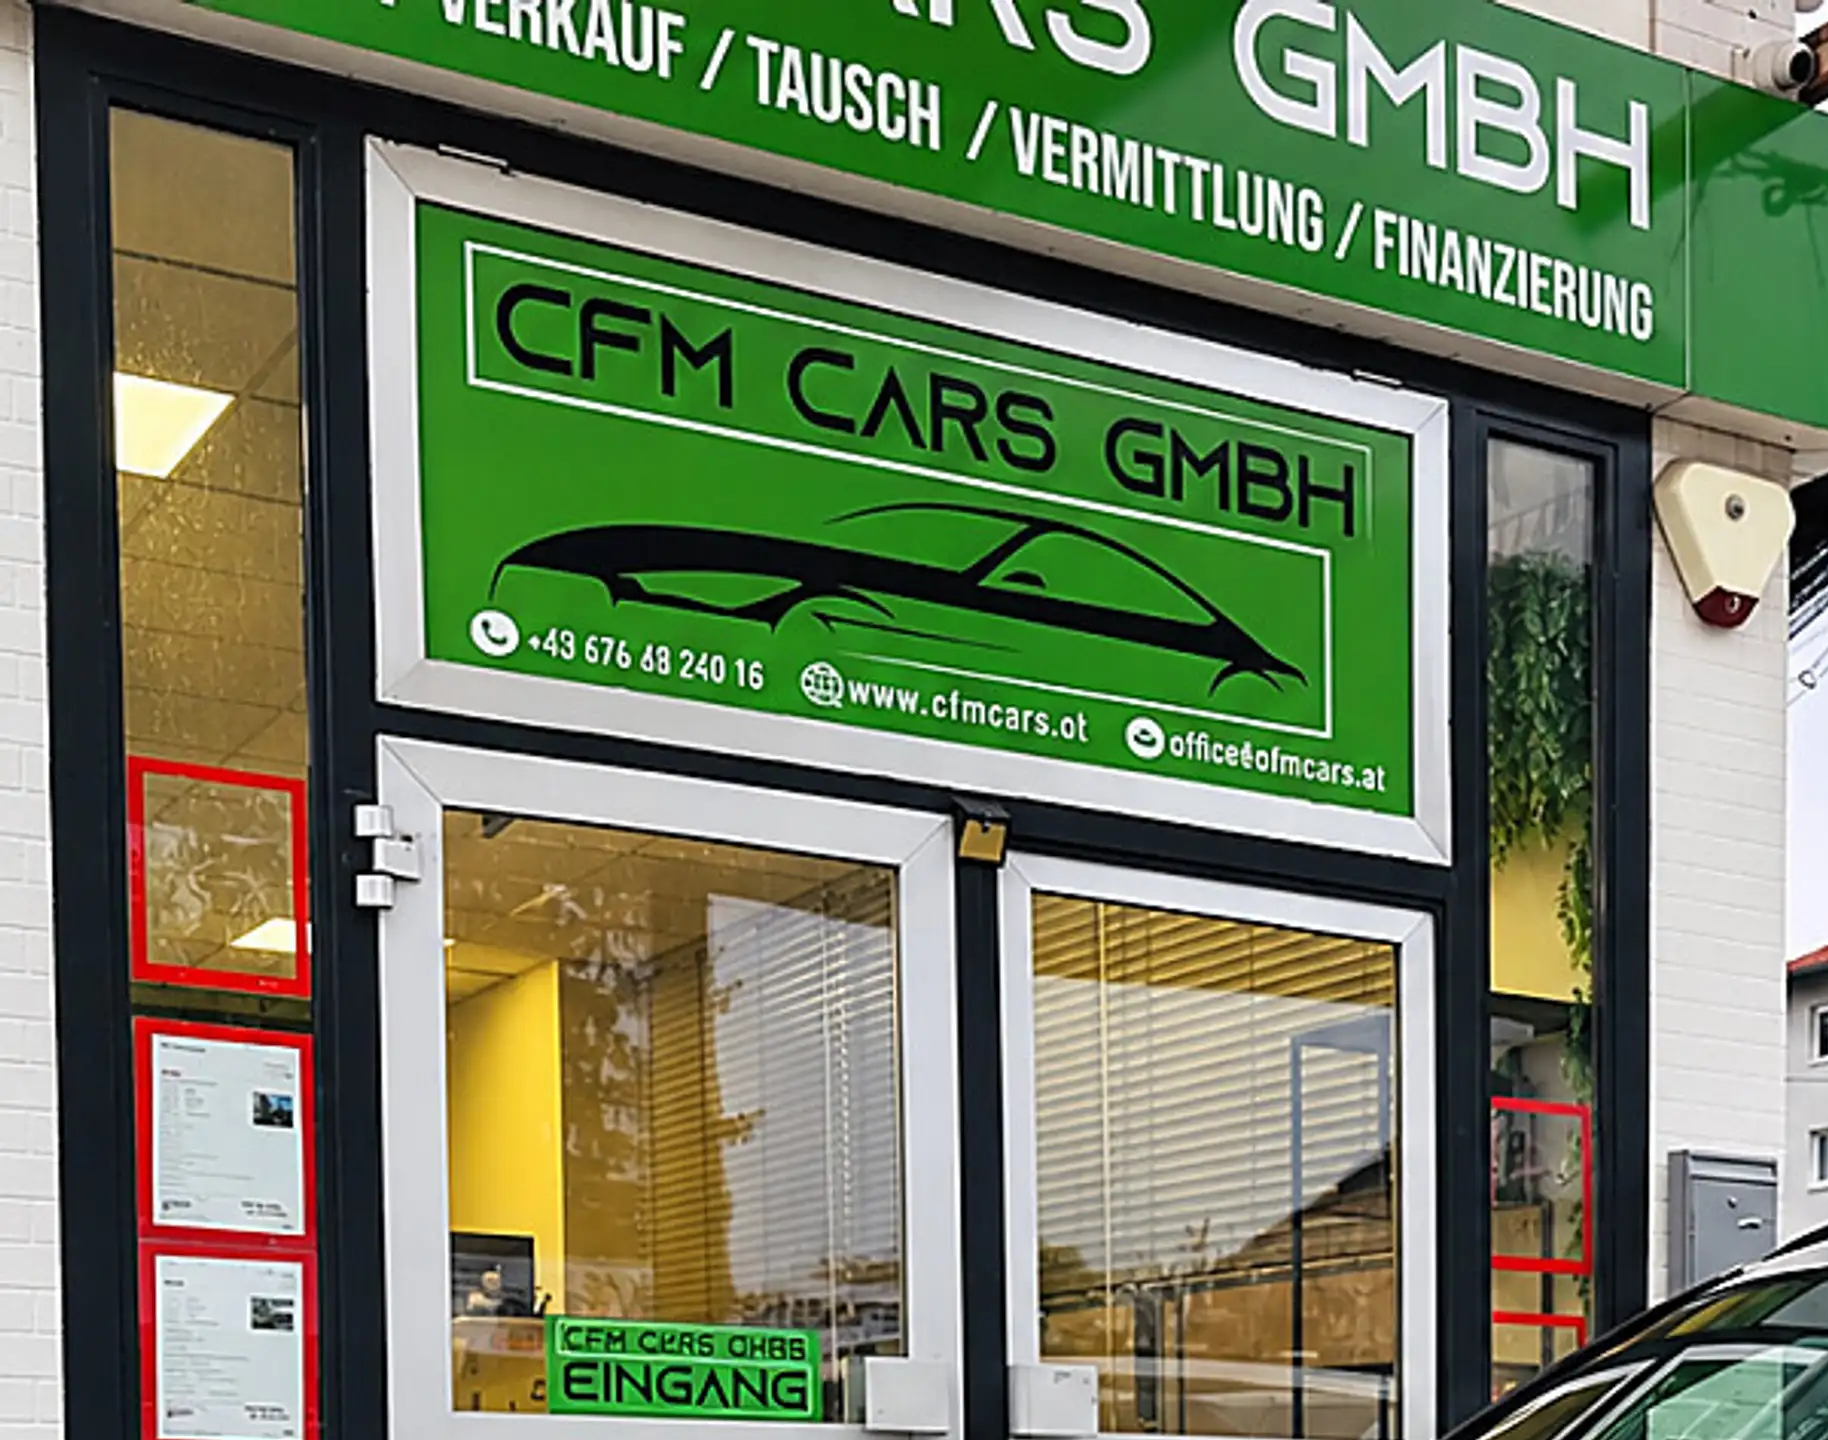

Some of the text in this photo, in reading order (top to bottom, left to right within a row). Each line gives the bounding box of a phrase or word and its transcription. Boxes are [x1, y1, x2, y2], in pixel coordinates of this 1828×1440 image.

[746, 35, 941, 151] TAUSCH
[1009, 105, 1325, 252] VERMITTLUNG
[1373, 211, 1654, 342] FINANZIERUNG
[1232, 0, 1650, 230] GMBH
[496, 283, 1355, 538] CFM CARS GMBH
[583, 635, 632, 669] 676
[679, 650, 726, 684] 240
[734, 657, 765, 690] 16
[563, 1361, 809, 1411] EINGANG
